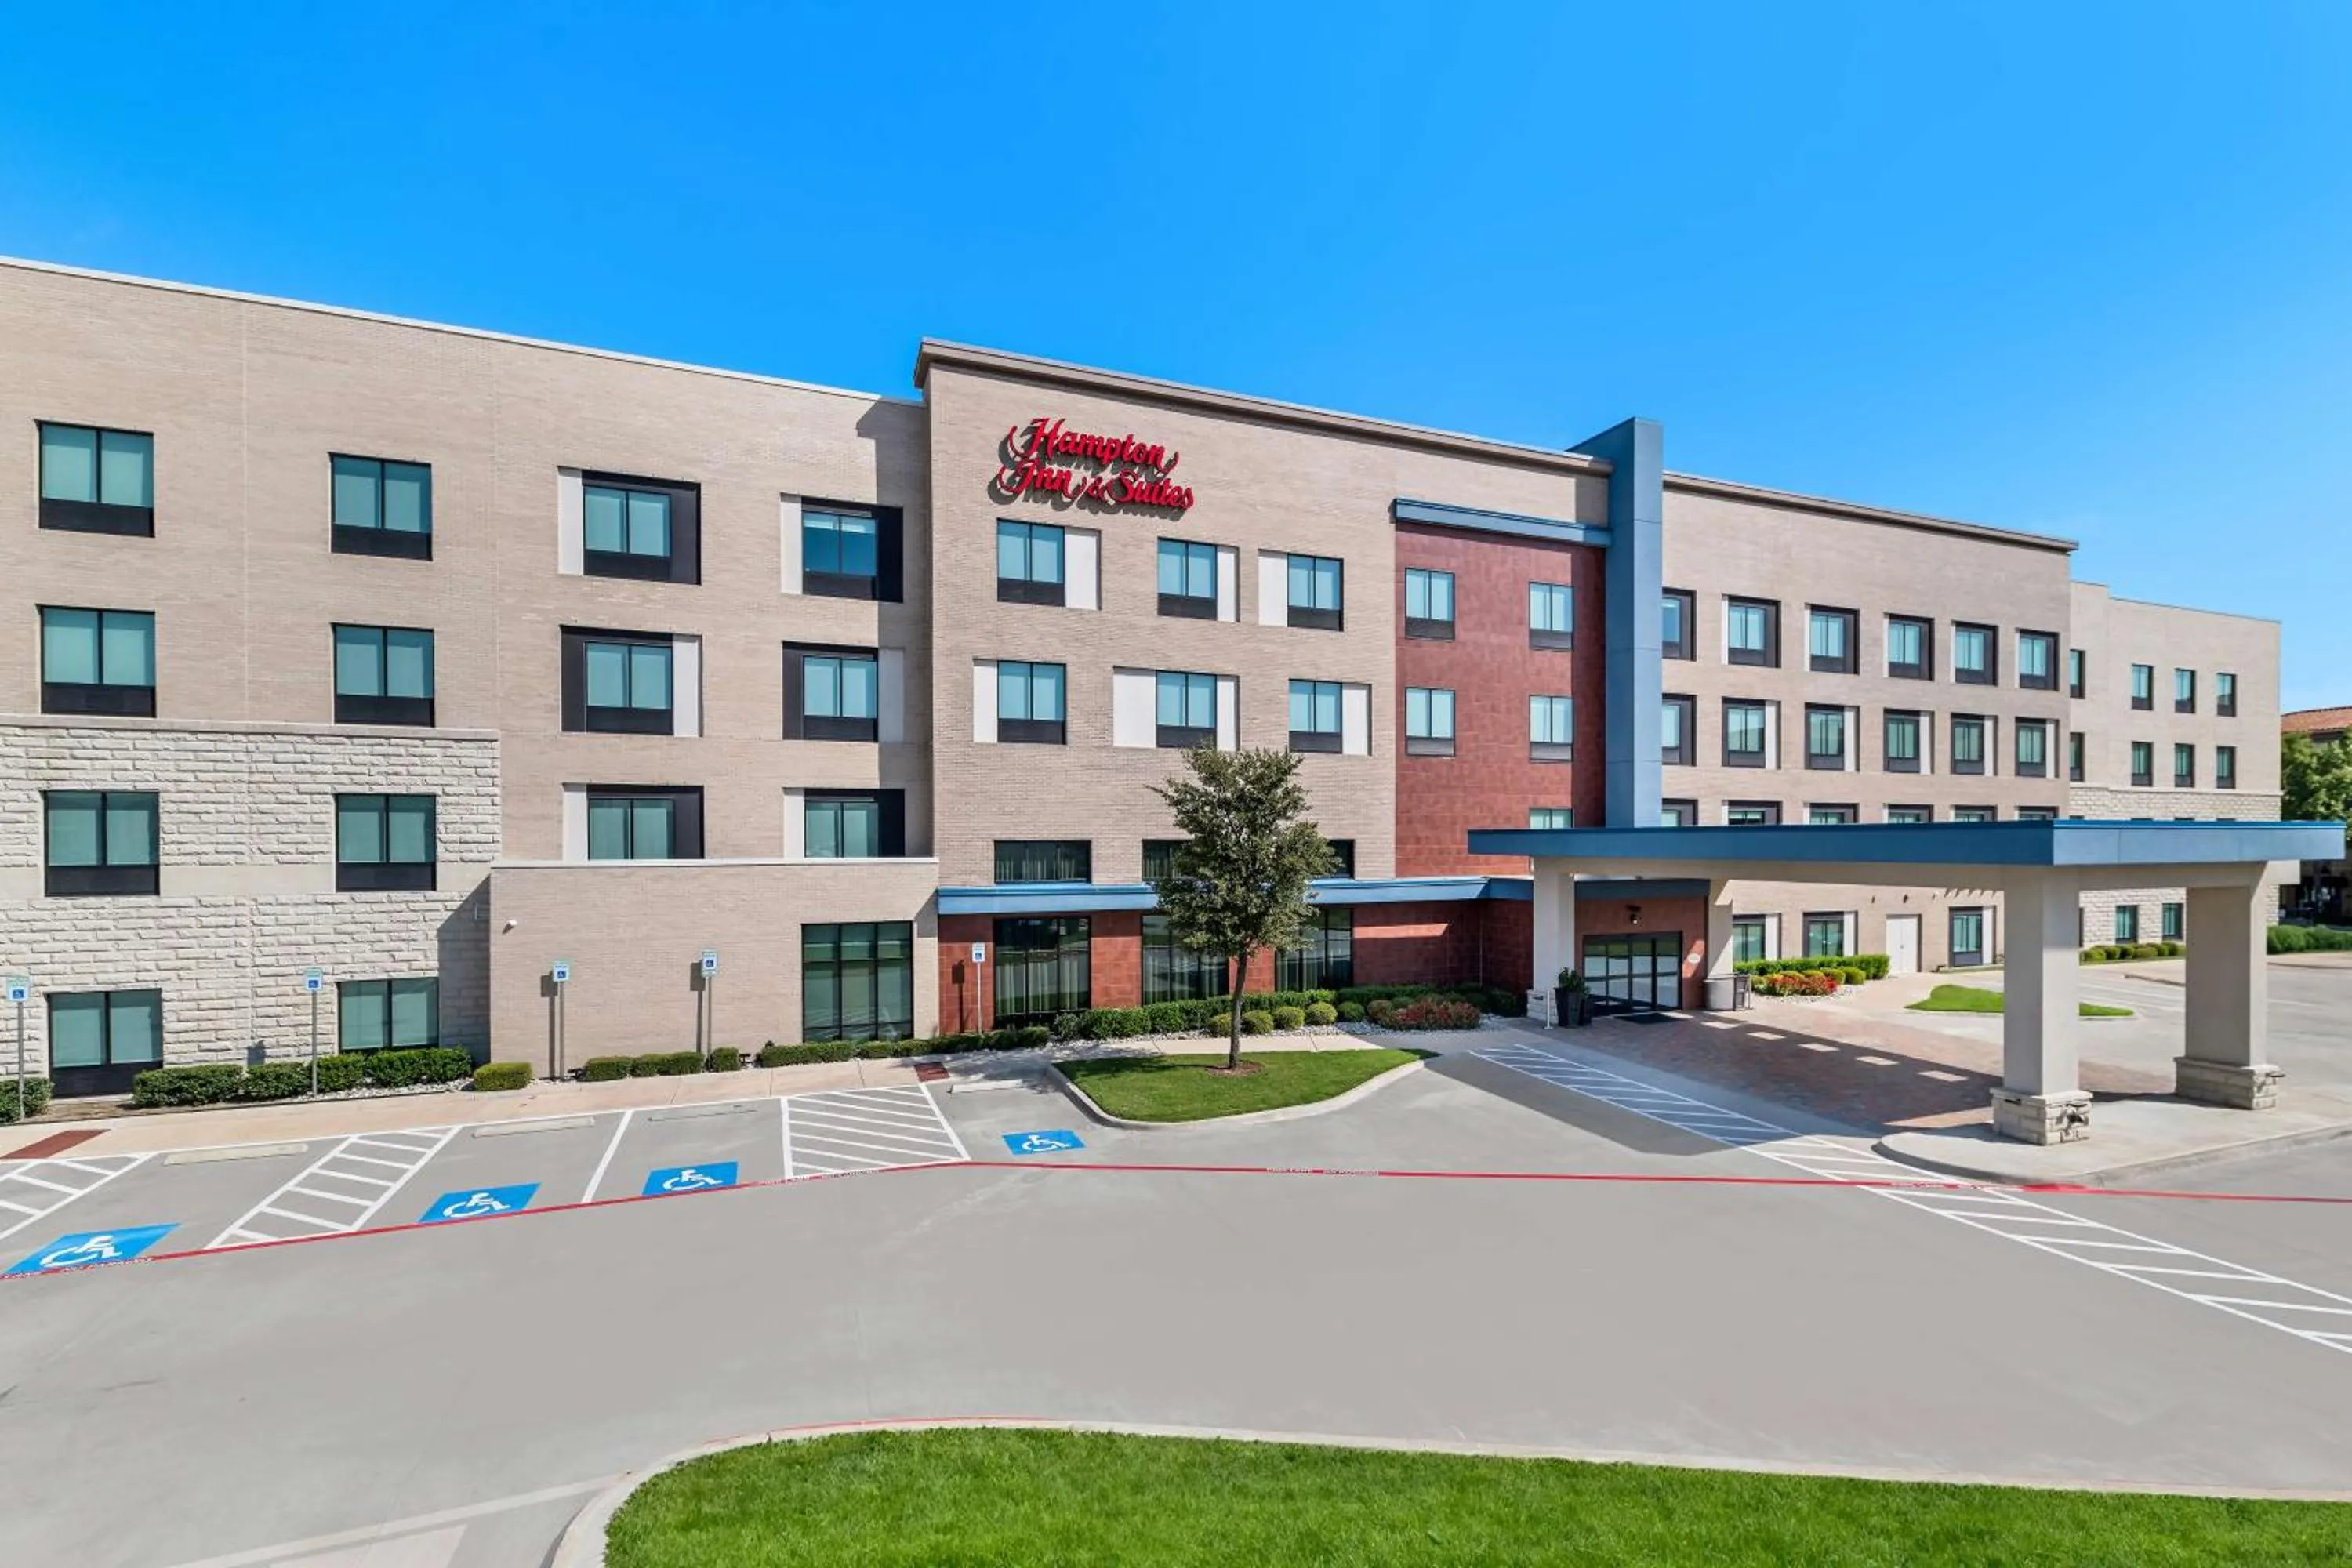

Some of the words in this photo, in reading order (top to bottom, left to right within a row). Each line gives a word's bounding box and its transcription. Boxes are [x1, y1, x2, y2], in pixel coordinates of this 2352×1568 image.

[1008, 417, 1179, 473] Hampton
[998, 458, 1087, 499] Inn
[1087, 476, 1105, 502] &
[1106, 469, 1194, 510] Suites
